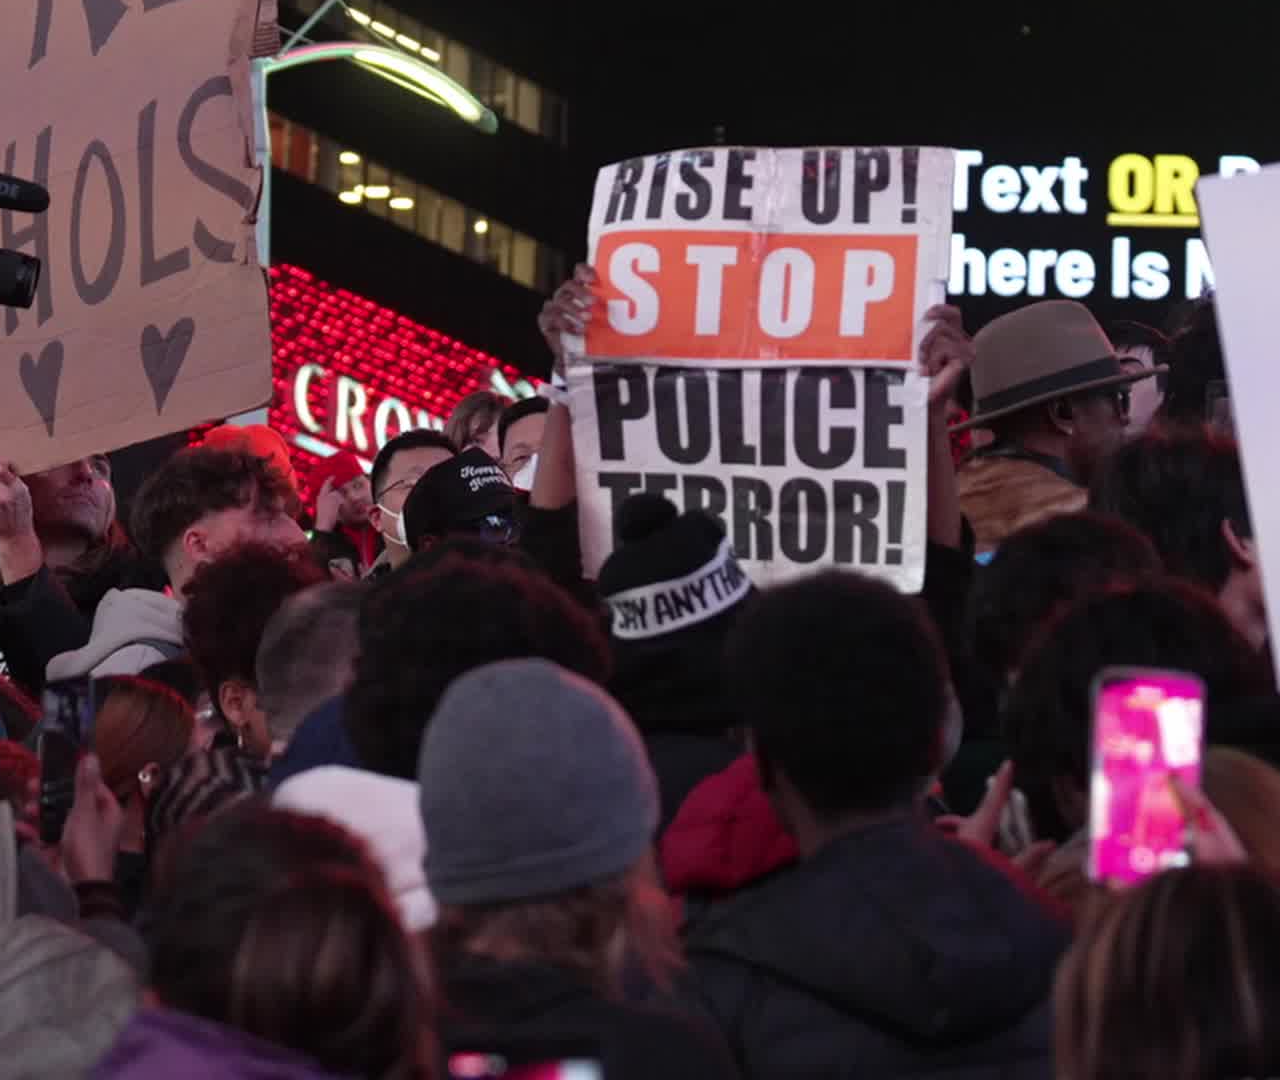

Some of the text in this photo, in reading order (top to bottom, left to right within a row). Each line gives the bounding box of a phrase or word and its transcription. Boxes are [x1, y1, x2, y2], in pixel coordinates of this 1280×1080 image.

[605, 147, 919, 225] RISE UP!
[953, 150, 1200, 216] Text OR
[607, 242, 896, 338] STOP
[1112, 237, 1170, 299] Is
[294, 363, 444, 452] CRO
[593, 368, 907, 470] POLICE
